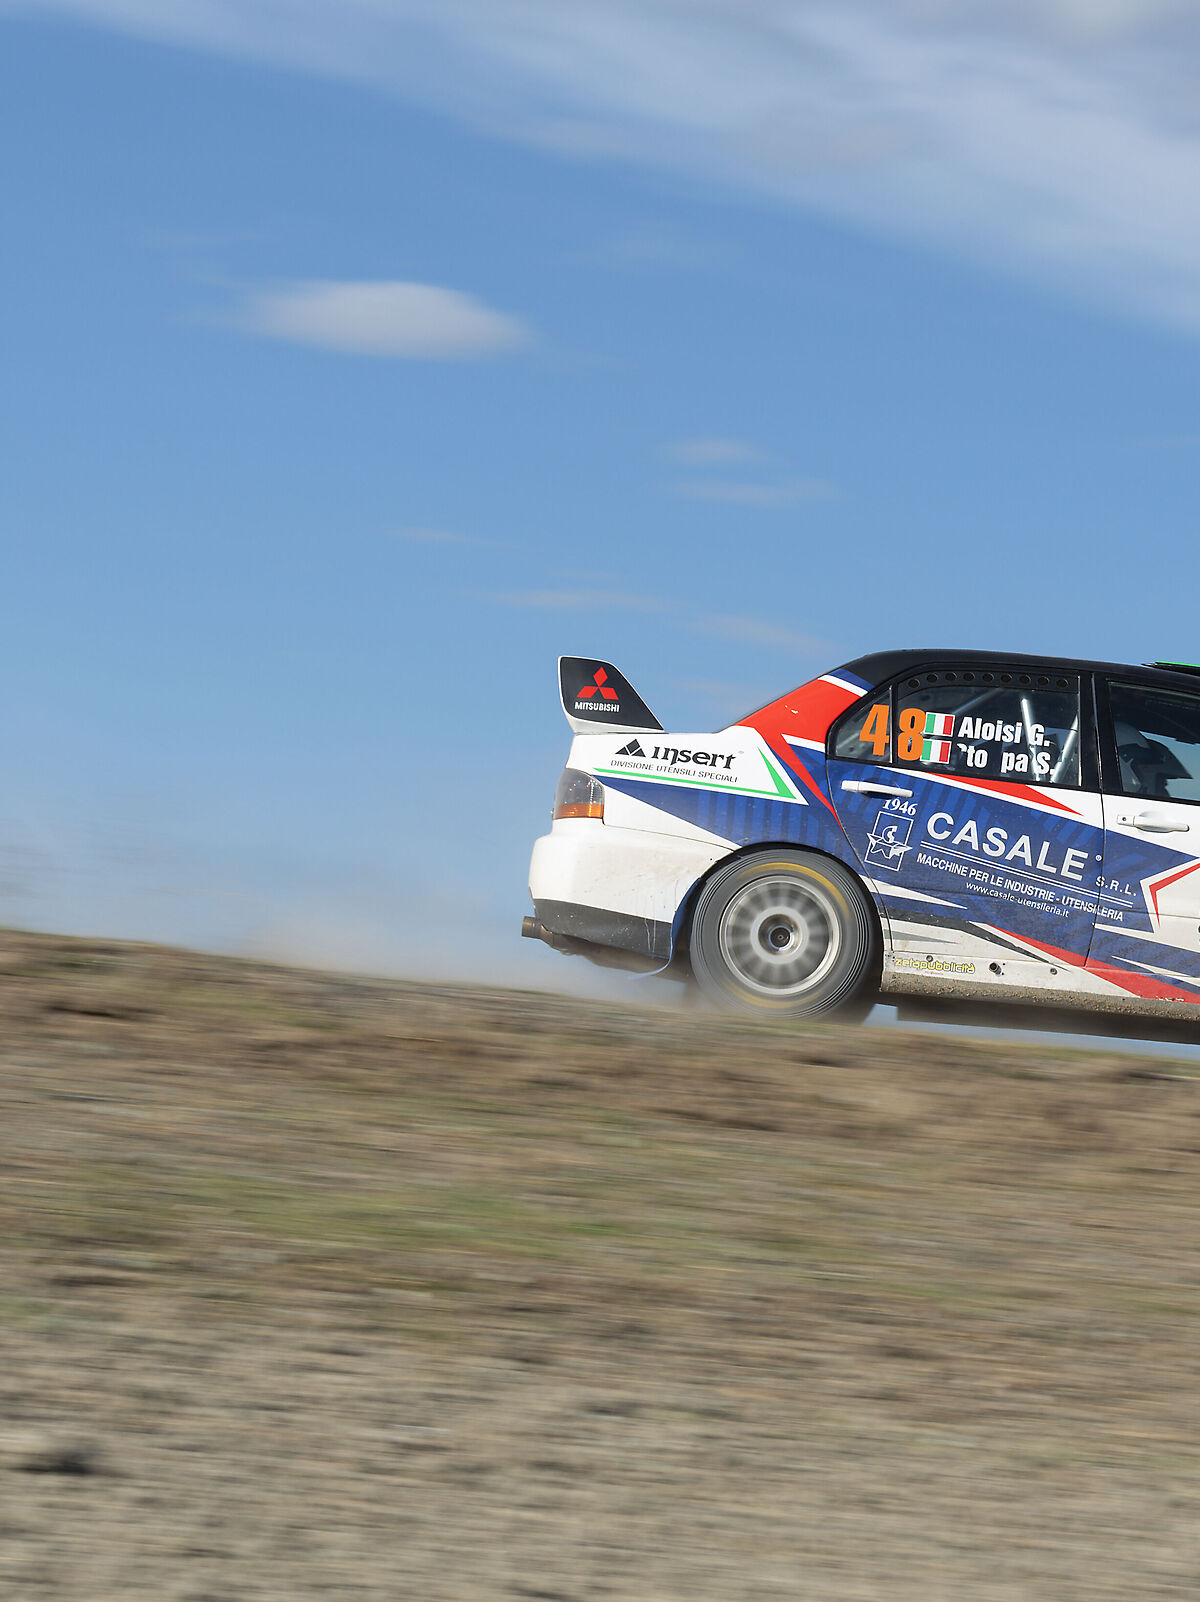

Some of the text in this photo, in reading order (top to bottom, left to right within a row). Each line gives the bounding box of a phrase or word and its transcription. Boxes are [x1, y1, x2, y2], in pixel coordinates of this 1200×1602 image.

[574, 701, 620, 713] MITSUBISHI
[859, 703, 926, 761] 48
[958, 716, 1051, 748] Aloisi G.
[610, 759, 738, 783] DIVISIONE UTENSILI SPECIALI
[651, 746, 736, 770] insert
[956, 742, 1028, 774] topa
[881, 798, 918, 816] 1946
[926, 811, 1089, 882] CASALE
[916, 852, 968, 877] MACCHINE
[968, 867, 989, 882] PER
[990, 873, 1003, 886] LE
[1003, 877, 1056, 902] INDUSTRIE
[1061, 896, 1124, 922] UTENSILERIA
[965, 881, 1070, 918] www.casale-utensileria.it
[1095, 874, 1137, 897] S.R.L.
